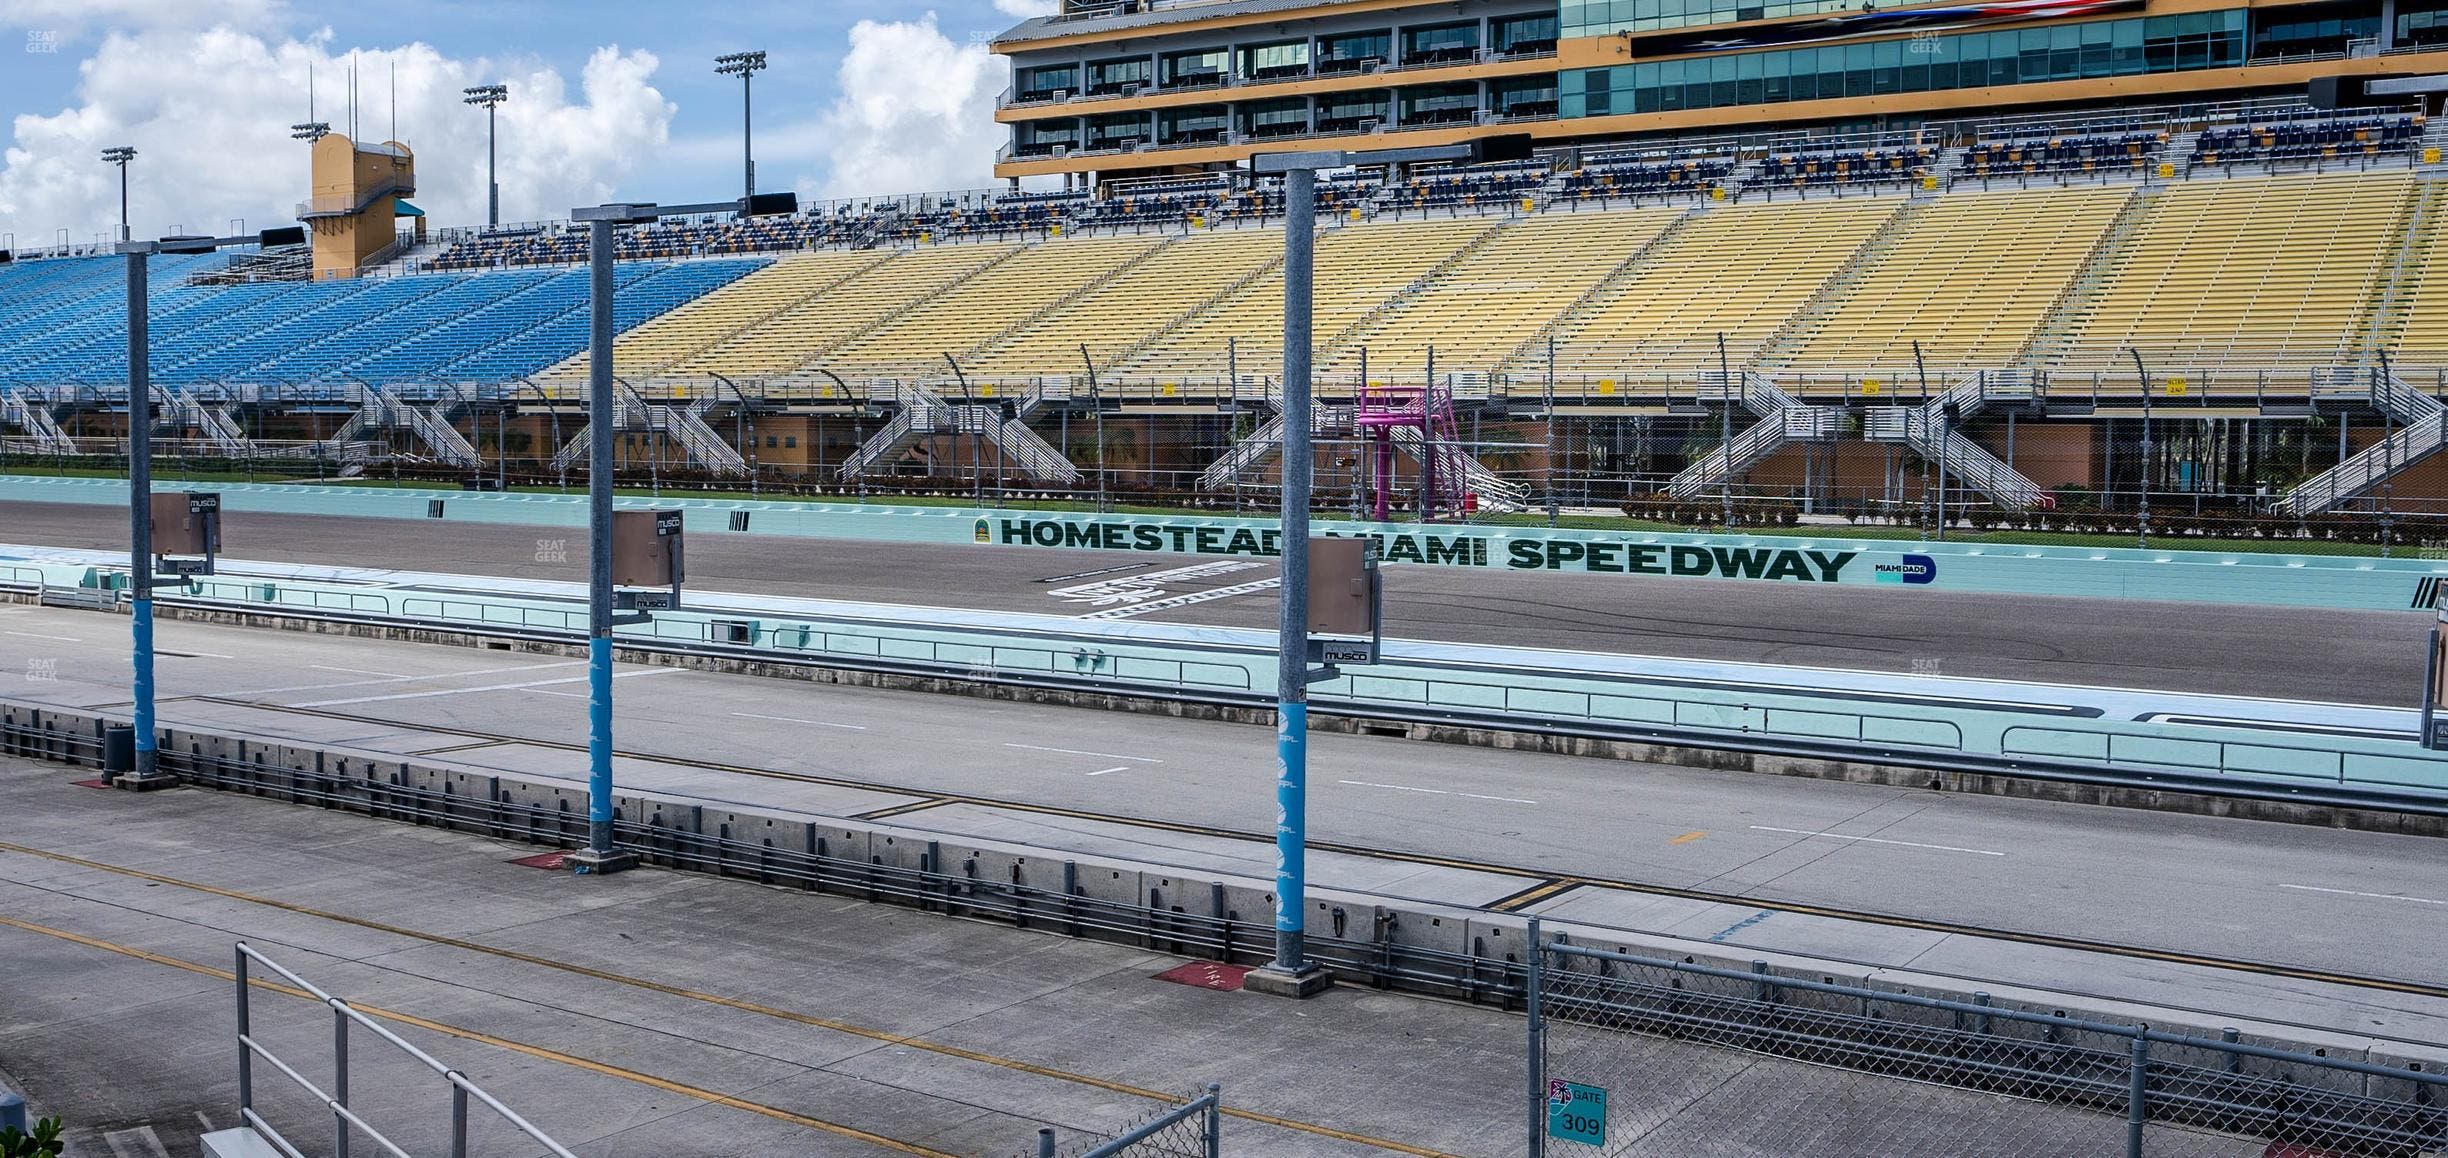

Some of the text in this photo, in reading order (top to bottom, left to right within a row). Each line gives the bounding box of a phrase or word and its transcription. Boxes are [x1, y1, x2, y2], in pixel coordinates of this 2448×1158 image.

[190, 498, 216, 507] musco
[657, 518, 680, 528] musco
[1508, 538, 1857, 583] SPEEDWAY
[637, 600, 668, 608] musco
[1325, 651, 1367, 661] musco
[1573, 1089, 1602, 1104] GATE
[1562, 1113, 1600, 1136] 309
